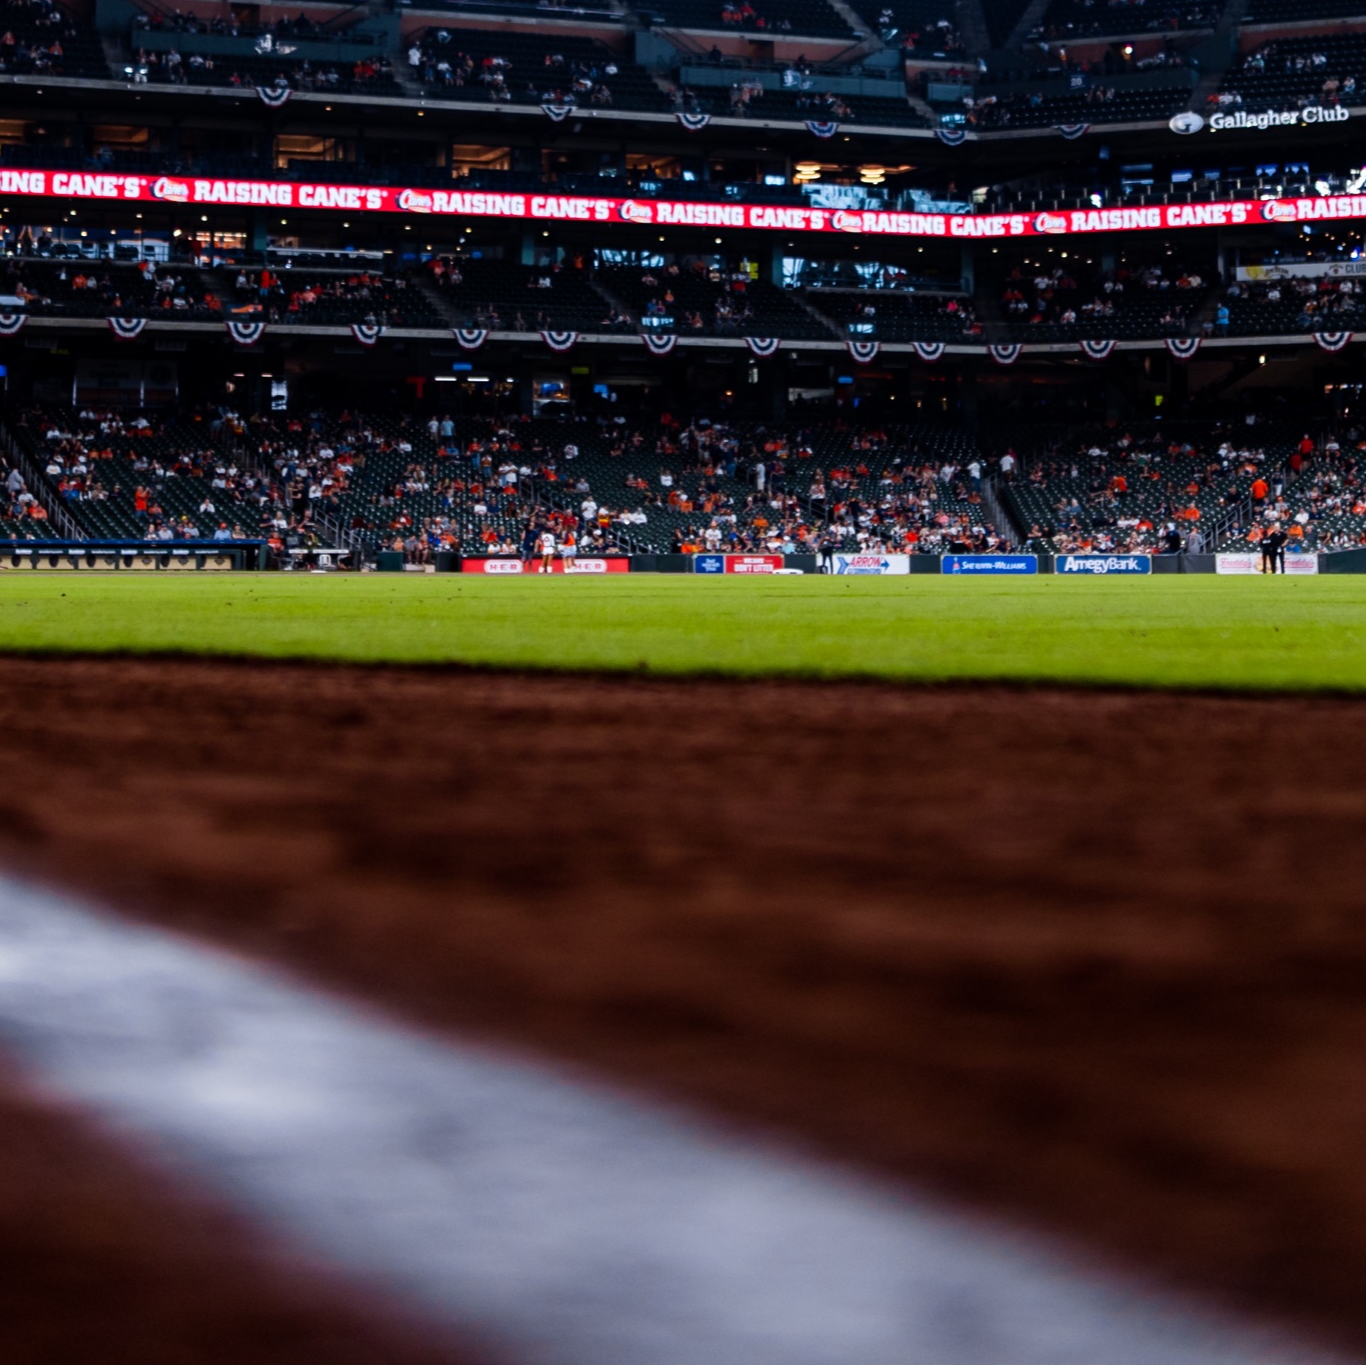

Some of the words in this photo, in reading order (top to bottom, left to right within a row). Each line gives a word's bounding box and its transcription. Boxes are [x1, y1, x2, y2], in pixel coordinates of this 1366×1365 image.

[1209, 109, 1299, 130] Gallagher
[1301, 105, 1349, 124] Club
[52, 173, 142, 198] CANE'S
[154, 177, 189, 200] Cane's
[193, 181, 292, 207] RAISING
[298, 185, 383, 210] CANE'S
[399, 189, 432, 211] Cane's
[432, 191, 525, 216] RAISING
[531, 196, 609, 220] CANE'S
[620, 199, 652, 222] Cane's
[1264, 200, 1297, 221] Cane's
[657, 202, 744, 227] RAISING
[750, 208, 825, 230] CANE'S
[832, 210, 862, 232] Cane's
[862, 212, 945, 235] RAISING
[951, 216, 1025, 237] CANE'S
[1035, 211, 1066, 233] Cane's
[1071, 207, 1161, 232] RAISING
[1166, 202, 1247, 228] CANE'S
[1345, 263, 1366, 274] CLUB
[850, 557, 882, 567] ARROW
